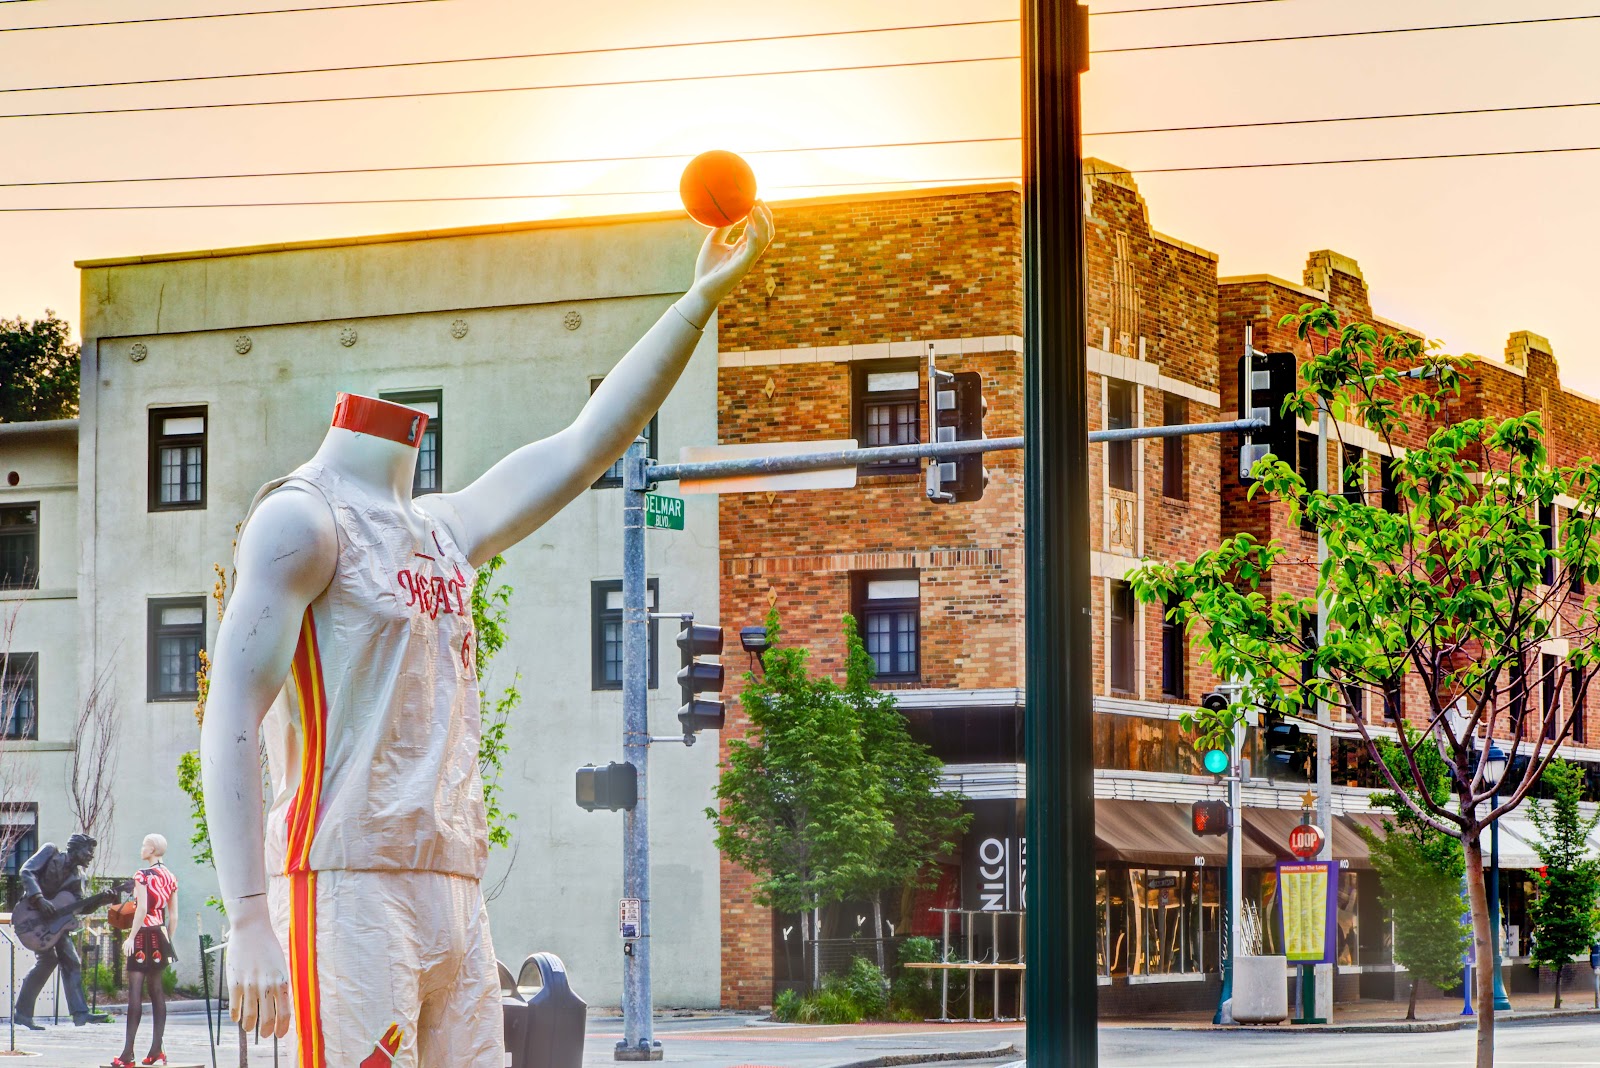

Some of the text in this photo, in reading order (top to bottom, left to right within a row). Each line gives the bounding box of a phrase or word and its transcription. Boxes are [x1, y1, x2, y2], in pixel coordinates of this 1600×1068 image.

[397, 566, 466, 620] HEAT
[461, 631, 472, 669] 6
[1291, 832, 1318, 848] LOOP
